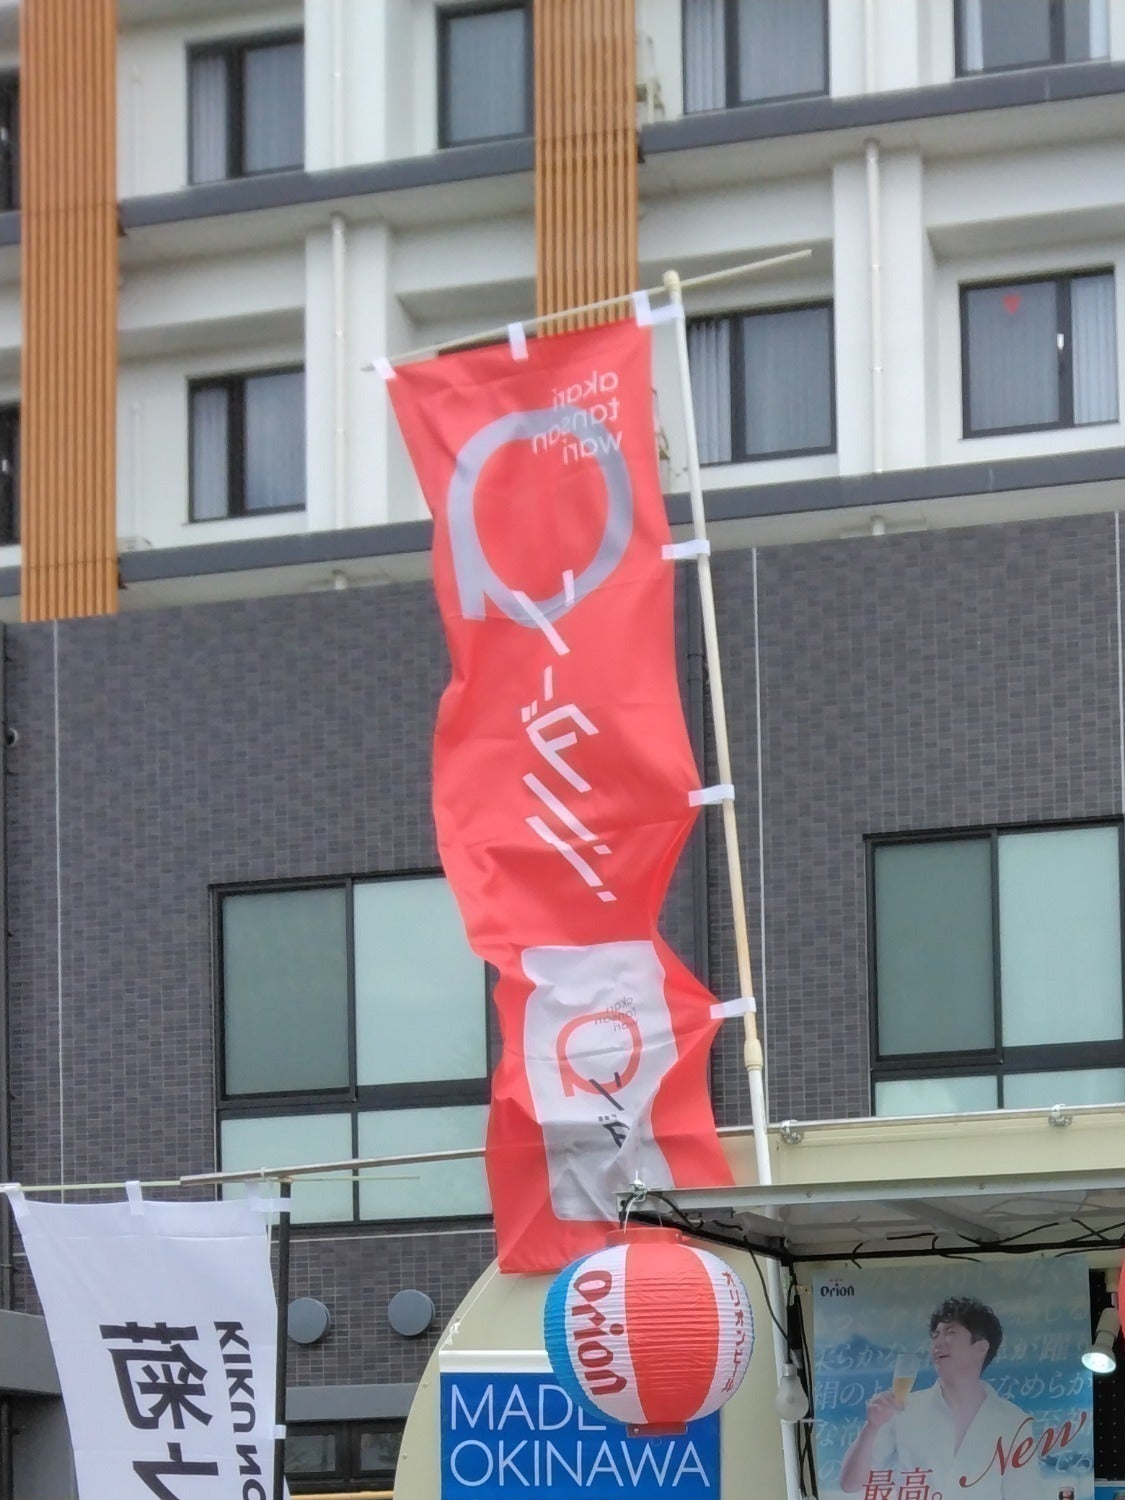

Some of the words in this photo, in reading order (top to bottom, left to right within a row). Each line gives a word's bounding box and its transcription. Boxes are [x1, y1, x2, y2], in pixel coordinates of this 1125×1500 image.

[820, 1282, 855, 1298] Orion
[571, 1269, 627, 1396] Orion
[449, 1439, 711, 1487] OKINAWA
[959, 1411, 1087, 1488] New
